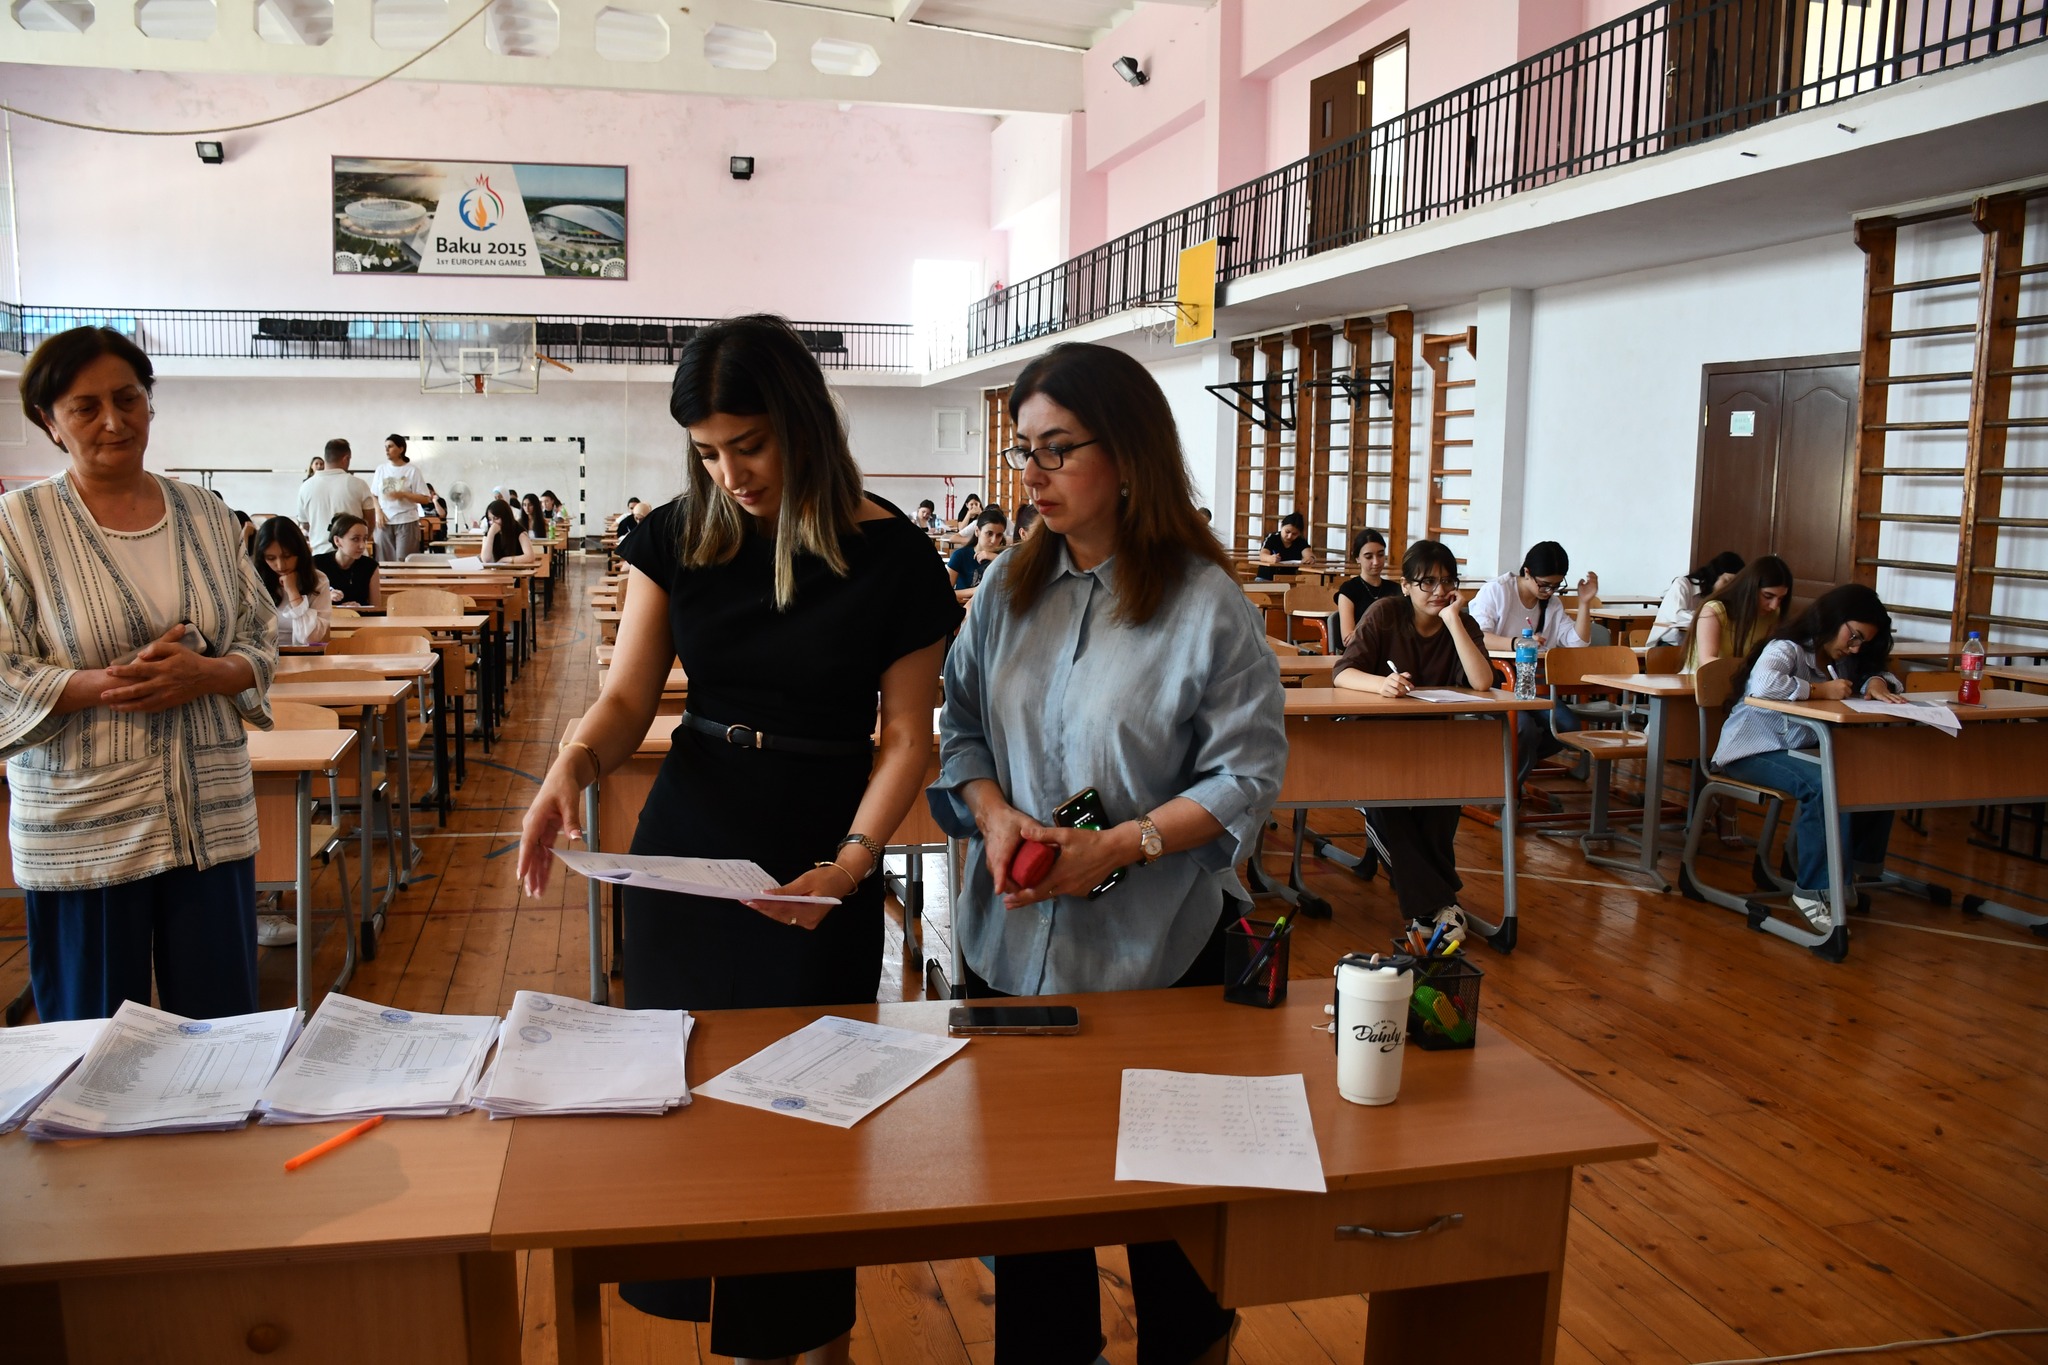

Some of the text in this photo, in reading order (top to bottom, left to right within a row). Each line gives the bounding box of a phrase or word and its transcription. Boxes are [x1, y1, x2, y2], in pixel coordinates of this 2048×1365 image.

[436, 236, 527, 257] Baku 2015
[451, 258, 496, 266] EUROPEAN
[498, 259, 527, 267] GAMES
